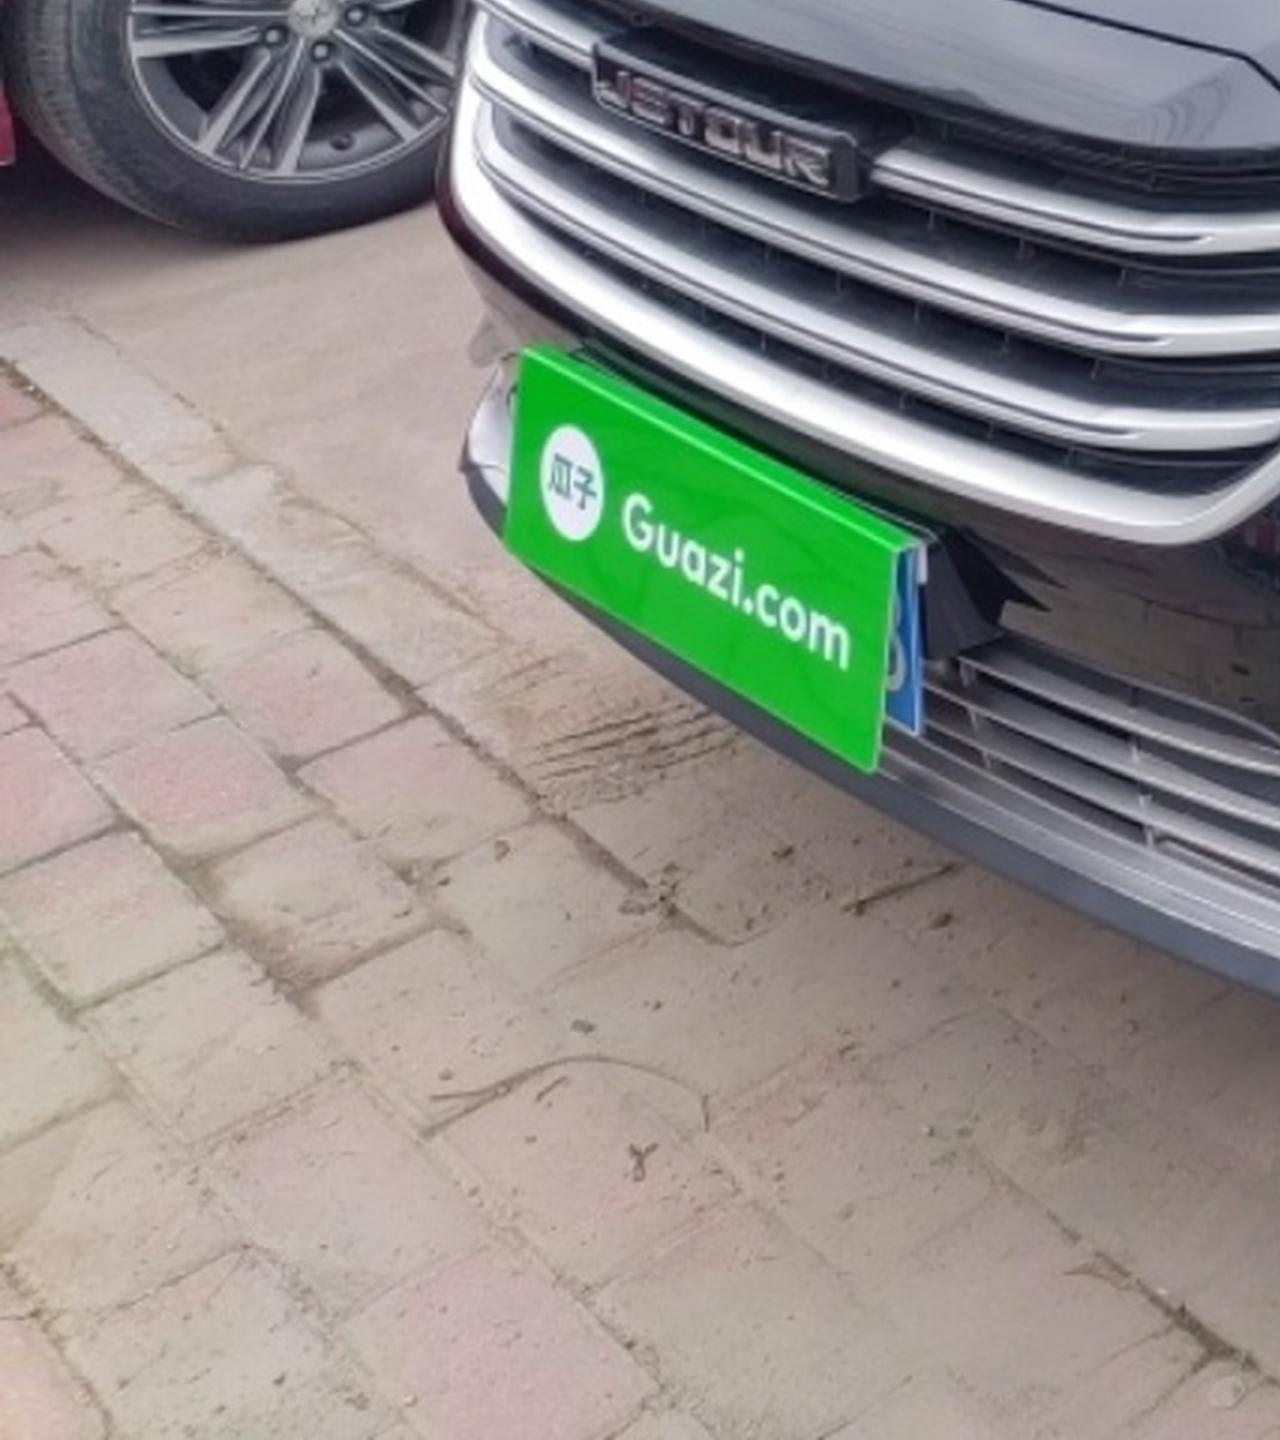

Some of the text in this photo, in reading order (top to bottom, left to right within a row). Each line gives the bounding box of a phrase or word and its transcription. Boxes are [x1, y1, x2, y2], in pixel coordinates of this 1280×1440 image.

[596, 70, 831, 187] JETOUR
[549, 453, 598, 510] 瓜子
[622, 492, 851, 671] Guazi.com
